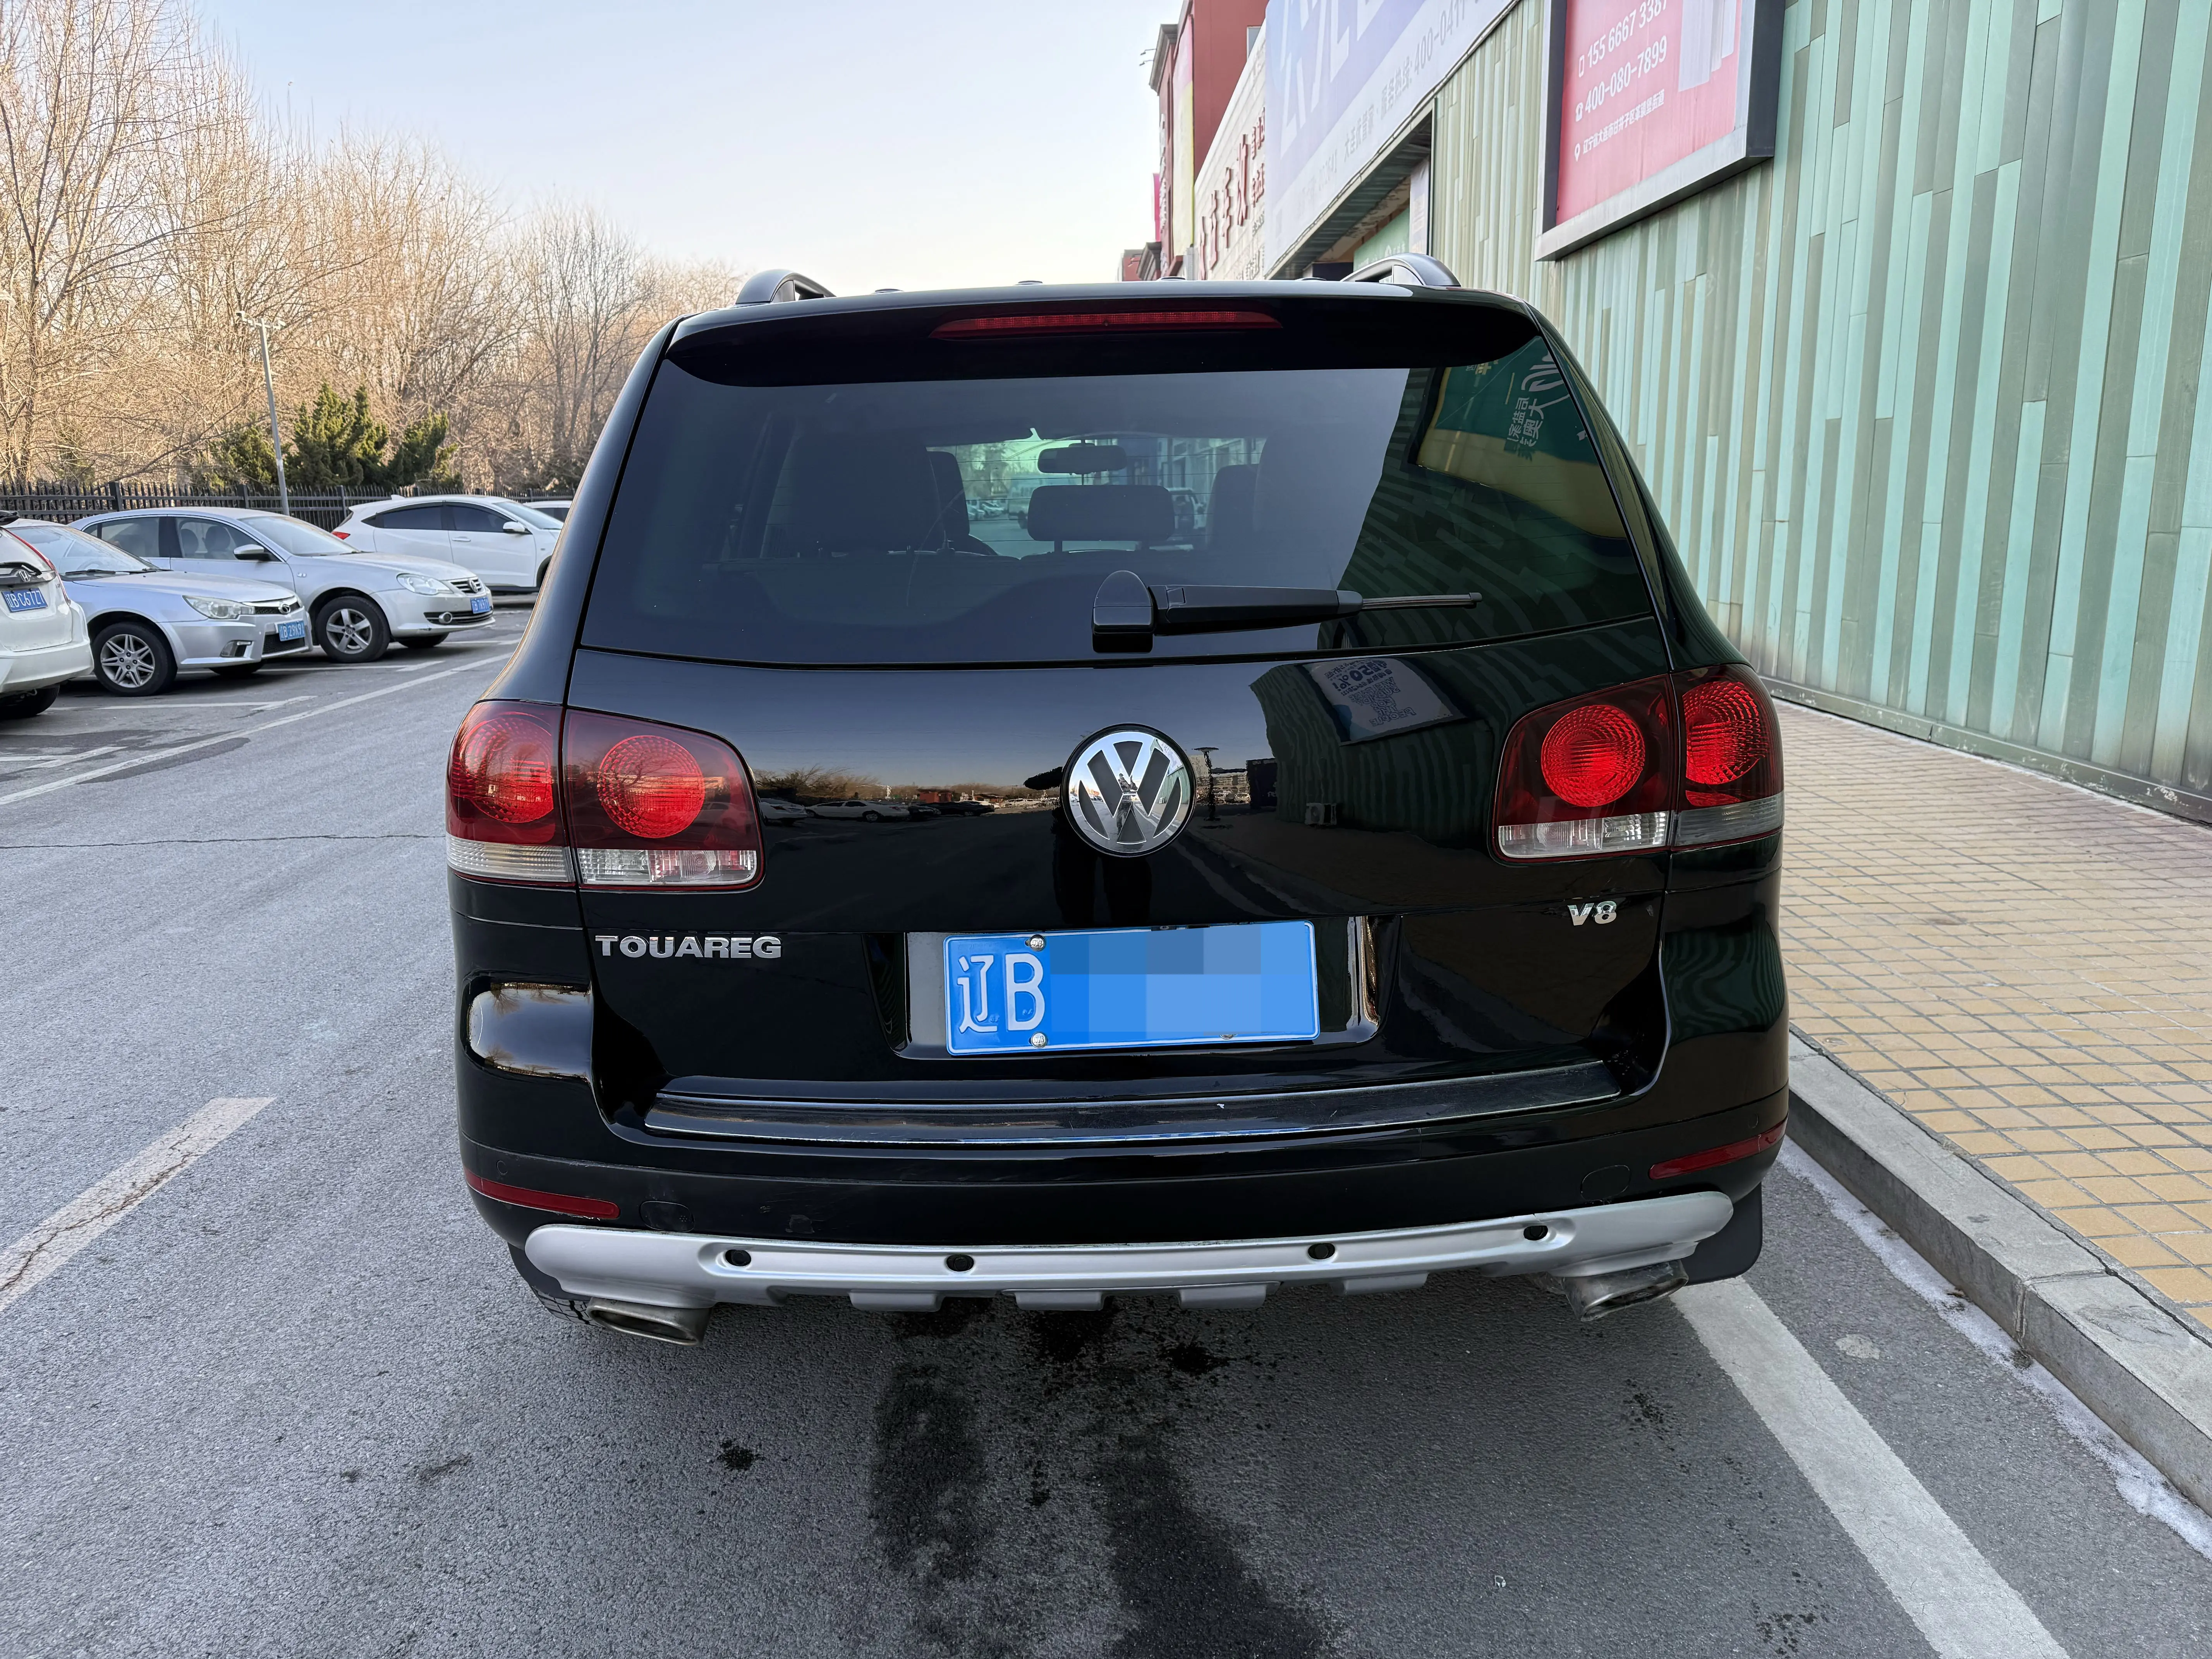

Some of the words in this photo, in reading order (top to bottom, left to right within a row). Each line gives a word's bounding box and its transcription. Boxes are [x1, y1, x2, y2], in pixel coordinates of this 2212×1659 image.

[1588, 34, 1606, 68] 155
[1608, 9, 1637, 52] 6667
[1585, 35, 1667, 113] 400-080-7899
[1568, 901, 1617, 926] V8
[595, 935, 782, 958] TOUAREG
